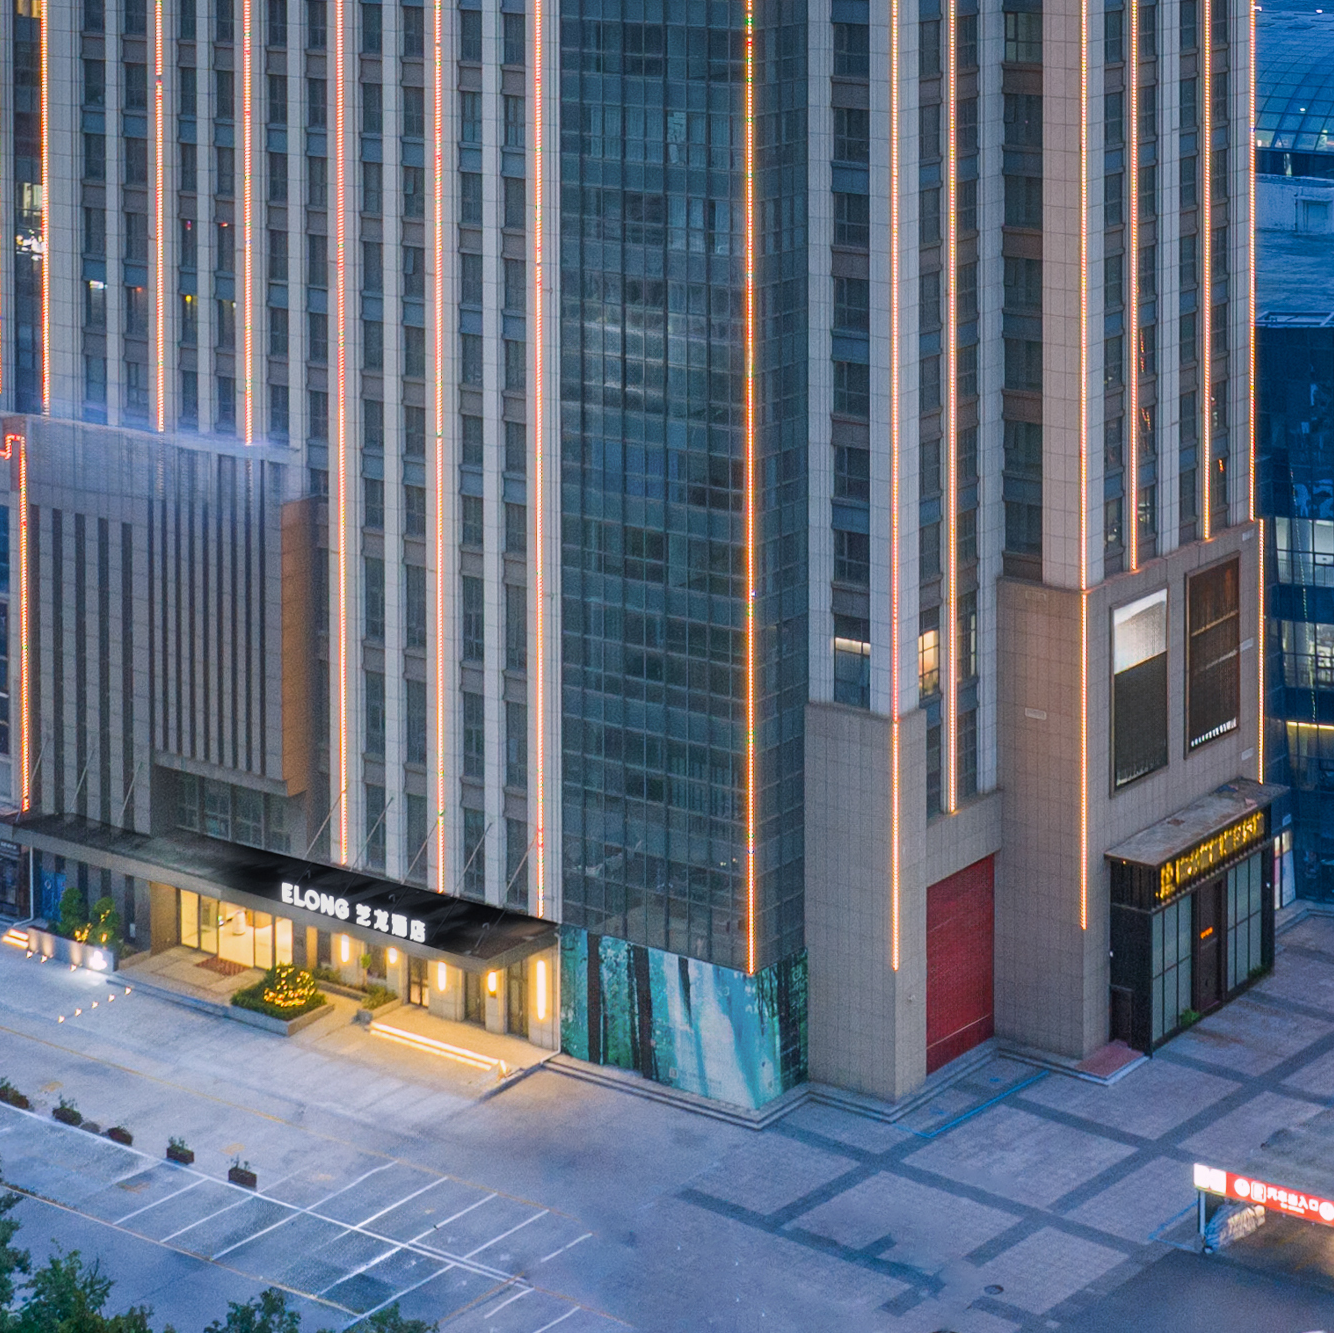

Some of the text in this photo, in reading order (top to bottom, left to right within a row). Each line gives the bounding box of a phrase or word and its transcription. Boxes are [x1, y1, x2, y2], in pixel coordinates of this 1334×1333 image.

[281, 882, 426, 943] ELONG 艺龙酒店
